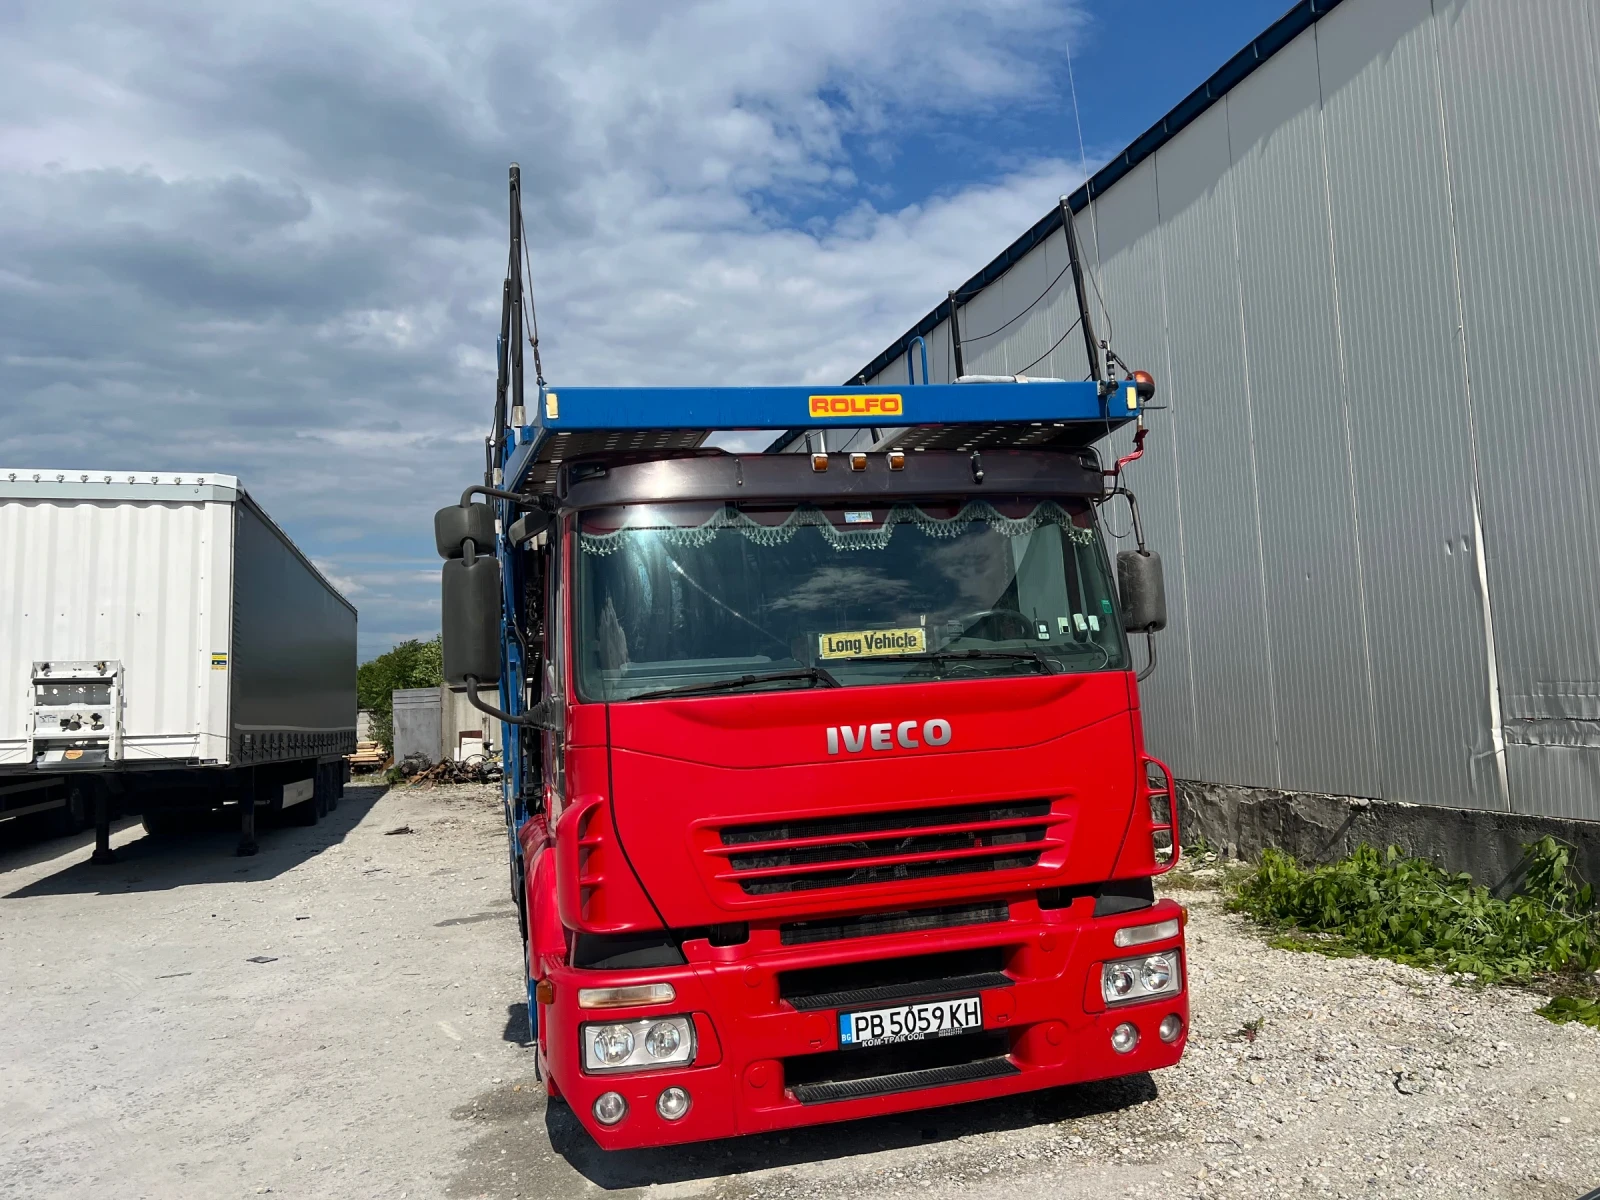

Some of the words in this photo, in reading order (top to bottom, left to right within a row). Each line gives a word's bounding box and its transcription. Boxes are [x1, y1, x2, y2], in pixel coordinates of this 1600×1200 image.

[812, 398, 899, 412] ROLFO
[828, 637, 861, 654] Long
[864, 632, 917, 650] Vehicle
[826, 718, 952, 754] IVECO
[890, 1007, 945, 1036] 5059
[841, 1033, 852, 1042] BG
